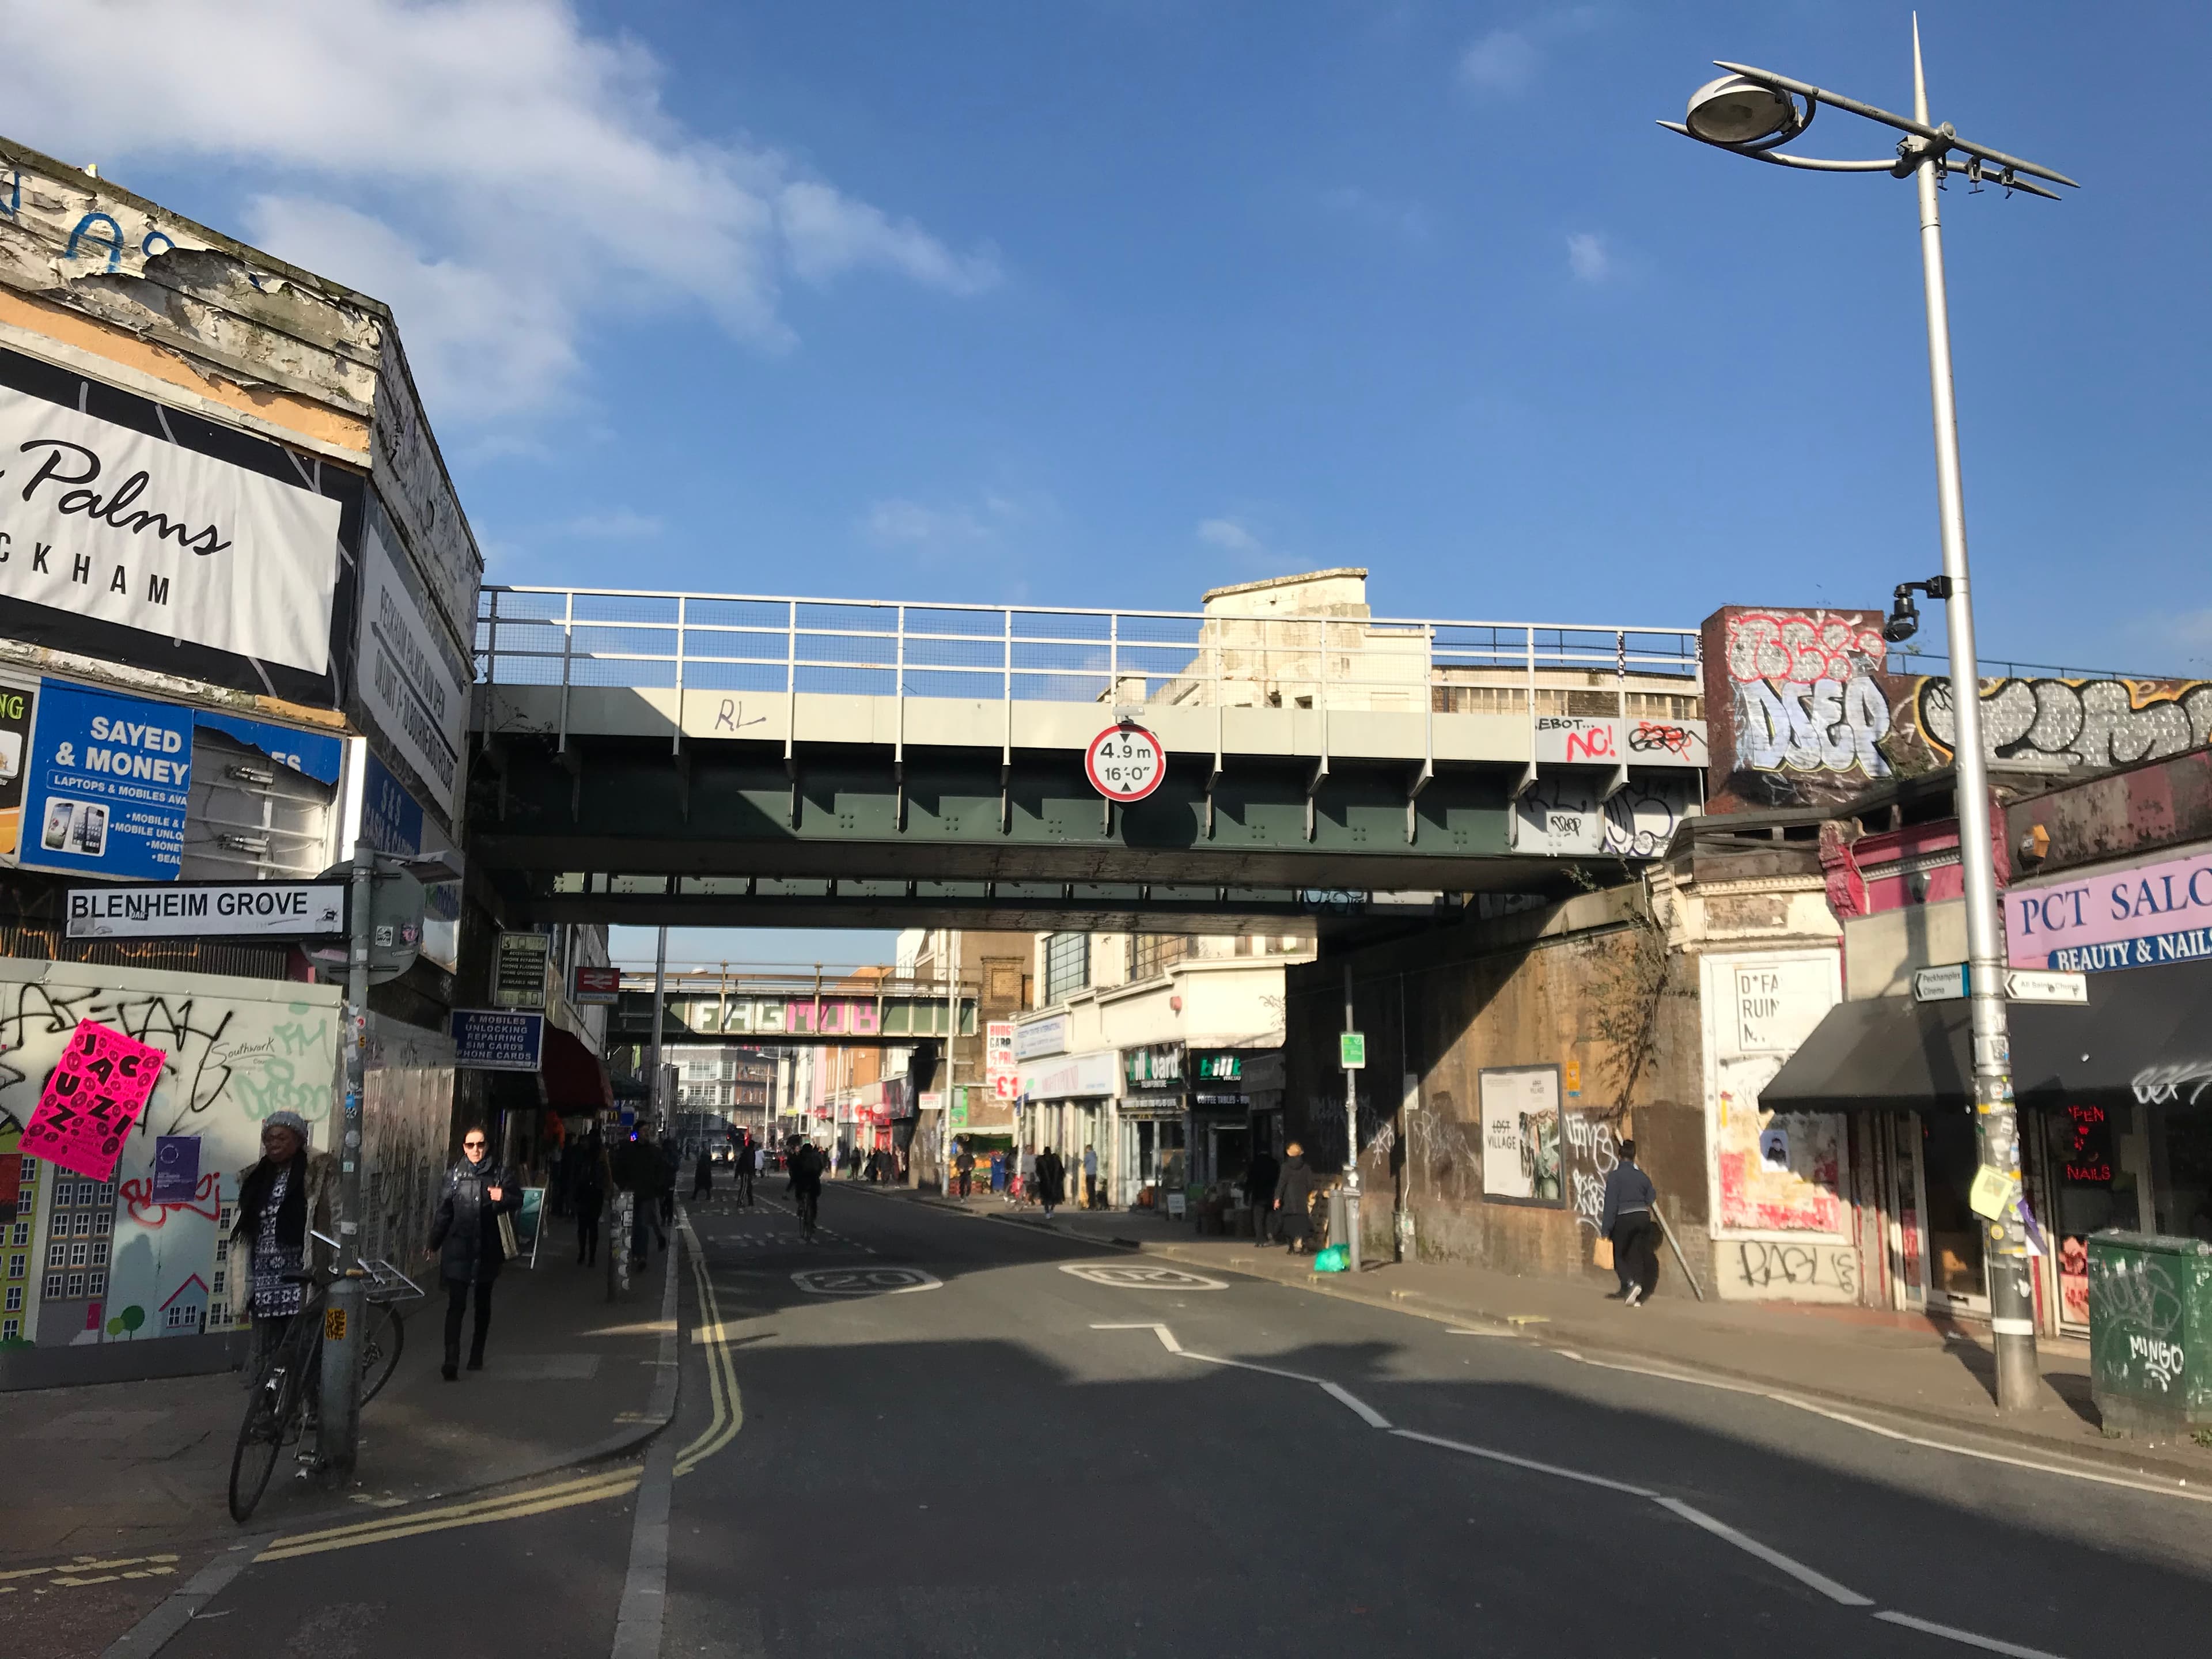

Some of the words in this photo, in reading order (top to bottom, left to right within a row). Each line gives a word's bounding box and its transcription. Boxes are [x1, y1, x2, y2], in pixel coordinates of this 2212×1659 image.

[20, 440, 232, 555] Palms
[90, 716, 181, 753] SAYED
[1100, 743, 1132, 759] 4.9
[1137, 748, 1151, 758] m
[55, 742, 76, 767] &
[85, 747, 190, 786] MONEY
[54, 775, 105, 791] LAPTOPS
[108, 784, 115, 794] &
[118, 786, 166, 802] MOBILES
[131, 812, 170, 827] MOBILE
[172, 819, 179, 828] &
[115, 822, 153, 836] MOBILE
[71, 892, 209, 918] BLENHEIM
[217, 891, 308, 916] GROVE
[2020, 888, 2090, 936] PCT
[2056, 940, 2130, 971] BEAUTY
[2136, 937, 2153, 964] &
[2158, 929, 2212, 960] NAIL
[1923, 971, 1961, 983] Peckhamplex
[1923, 986, 1945, 995] Cinema
[479, 1016, 526, 1025] MOBILES
[465, 1024, 528, 1034] UNLOCKING
[467, 1032, 524, 1043] REPAIRING
[457, 1050, 493, 1059] PHONE
[496, 1052, 531, 1060] CARDS
[488, 1043, 524, 1051] CARDS
[1487, 1135, 1516, 1150] VILLAGE
[2066, 1164, 2111, 1181] NAILS
[2130, 1335, 2184, 1374] MINGO
